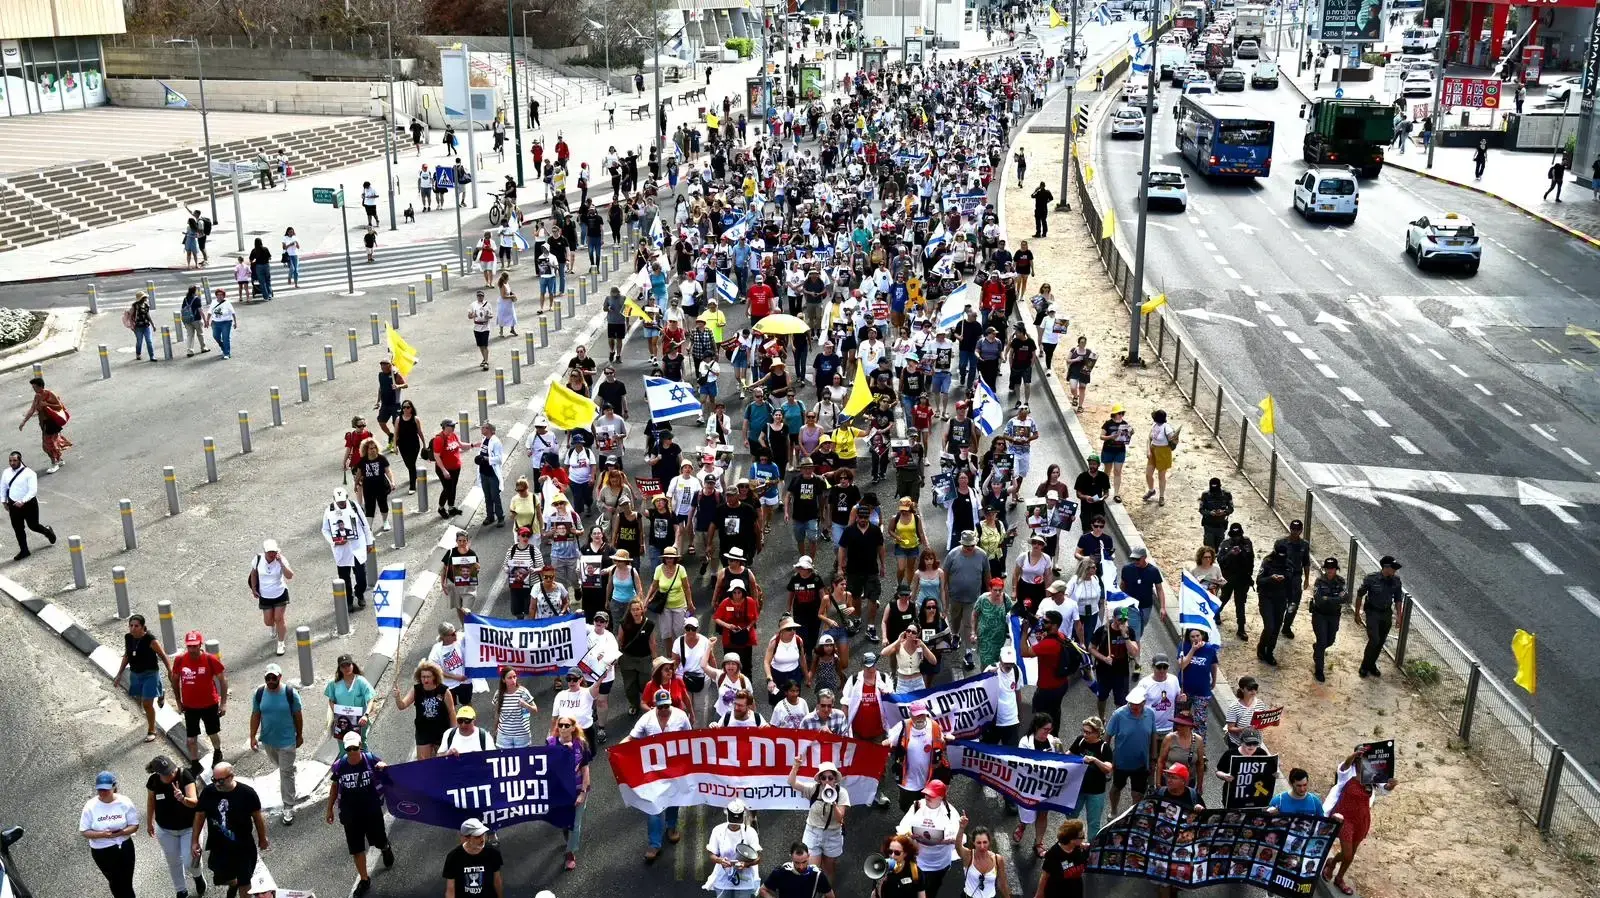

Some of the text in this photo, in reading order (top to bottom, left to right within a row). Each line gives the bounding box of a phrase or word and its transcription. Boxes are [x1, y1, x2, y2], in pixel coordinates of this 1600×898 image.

[479, 626, 571, 649] מחזירים אותם
[479, 644, 526, 664] עכשיו!
[530, 643, 574, 665] הביתה
[936, 687, 989, 715] מחזירים
[953, 700, 994, 732] הביתה
[486, 754, 548, 779] כי עוד
[640, 736, 741, 774] בחיים
[1236, 773, 1253, 786] DO
[1237, 762, 1267, 774] JUST
[446, 784, 492, 809] דרור
[500, 779, 549, 803] נפשי
[1015, 773, 1063, 798] הביתה
[1235, 785, 1250, 799] IT.
